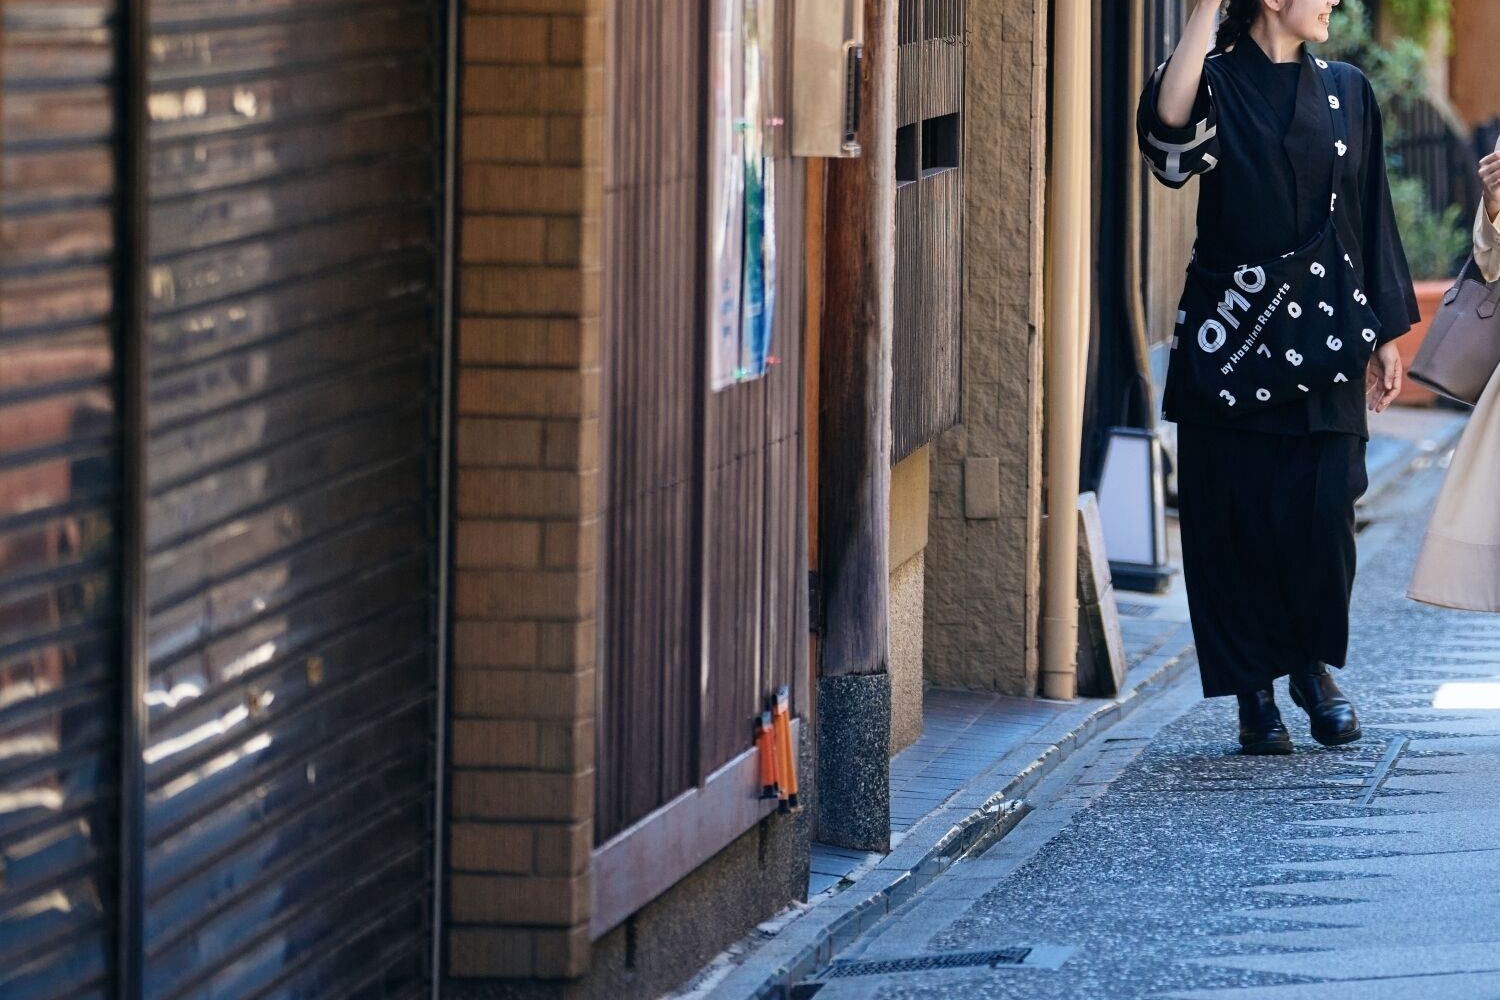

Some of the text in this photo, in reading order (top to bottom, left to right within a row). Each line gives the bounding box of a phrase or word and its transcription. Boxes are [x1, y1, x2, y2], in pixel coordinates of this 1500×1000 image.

[1197, 265, 1266, 353] OMO
[1318, 301, 1334, 317] 3
[1220, 282, 1291, 375] by Hoshino Resorts
[1256, 343, 1272, 359] 7
[1285, 348, 1304, 367] 8
[1219, 389, 1236, 407] 3
